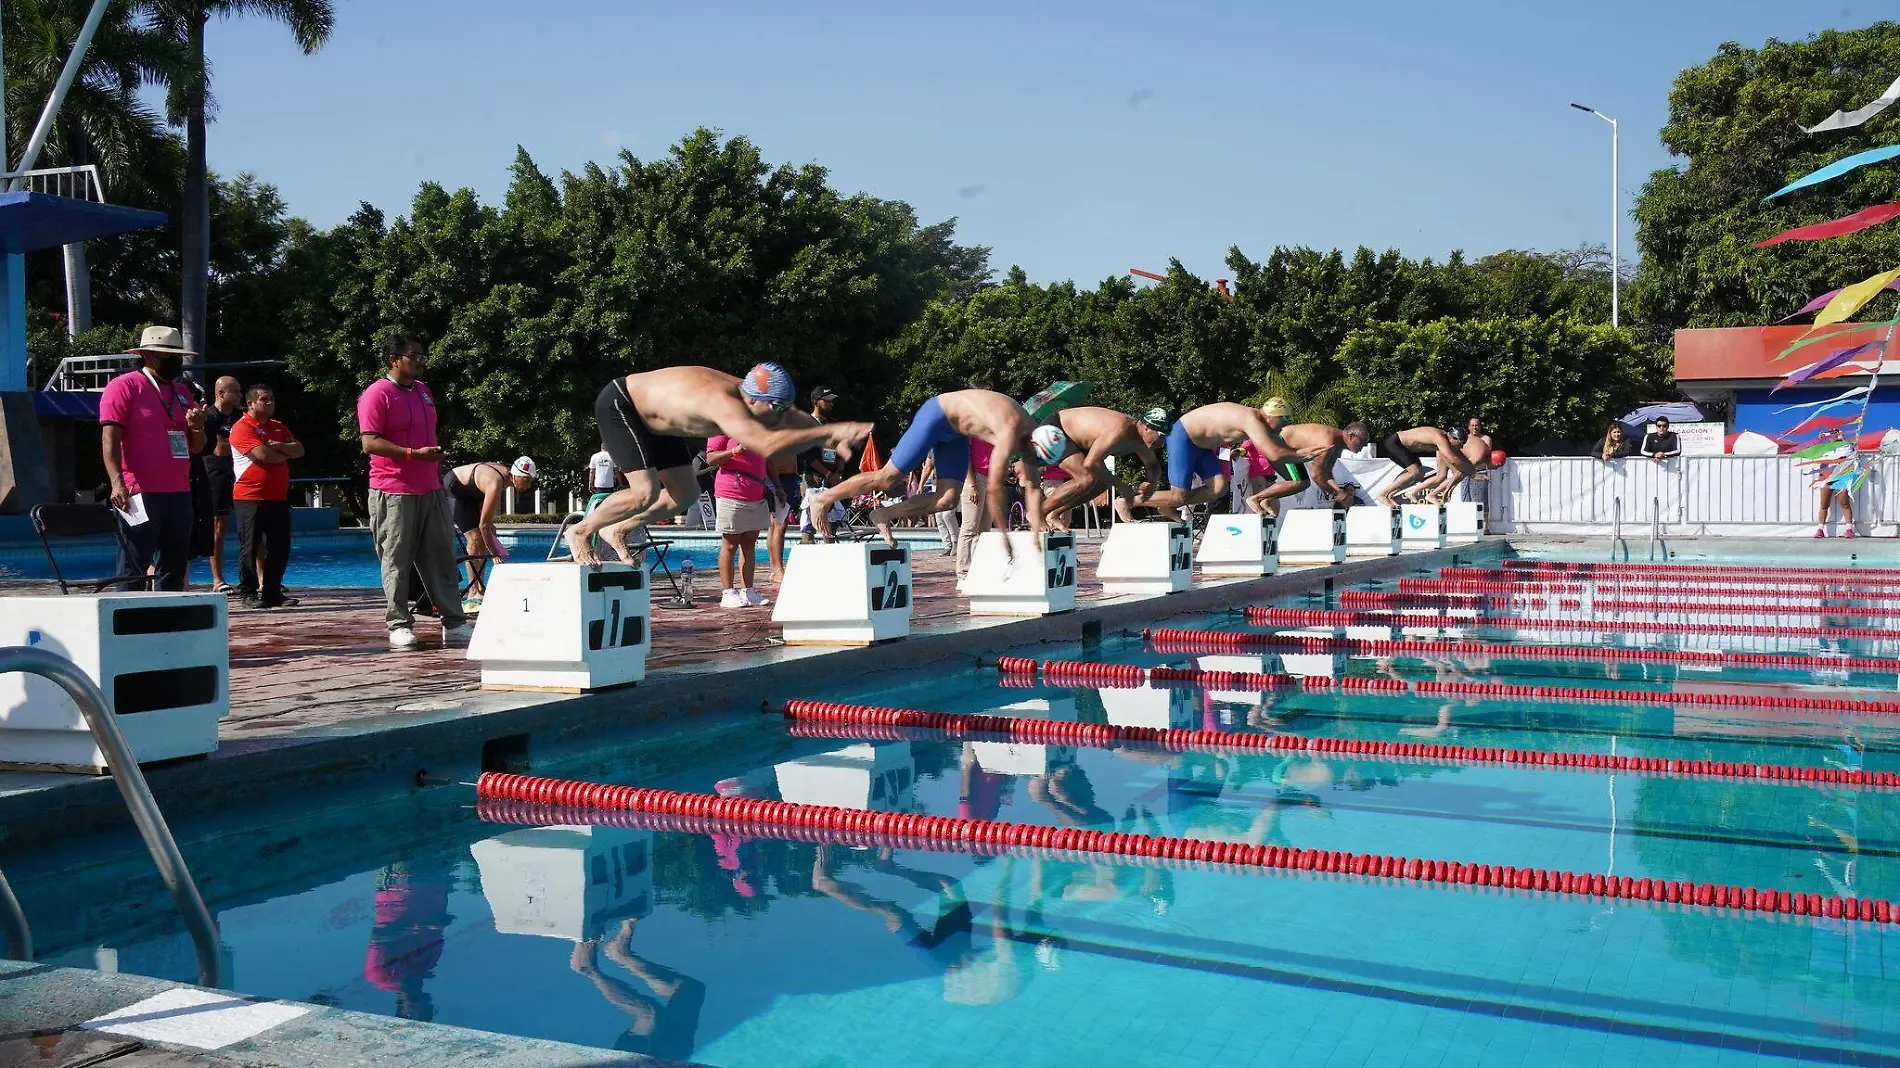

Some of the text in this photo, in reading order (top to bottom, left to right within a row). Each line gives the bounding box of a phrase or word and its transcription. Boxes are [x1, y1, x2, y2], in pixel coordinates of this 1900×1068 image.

[1056, 554, 1067, 587] 3
[522, 597, 530, 613] 1
[883, 570, 898, 609] 2
[609, 599, 621, 647] 1
